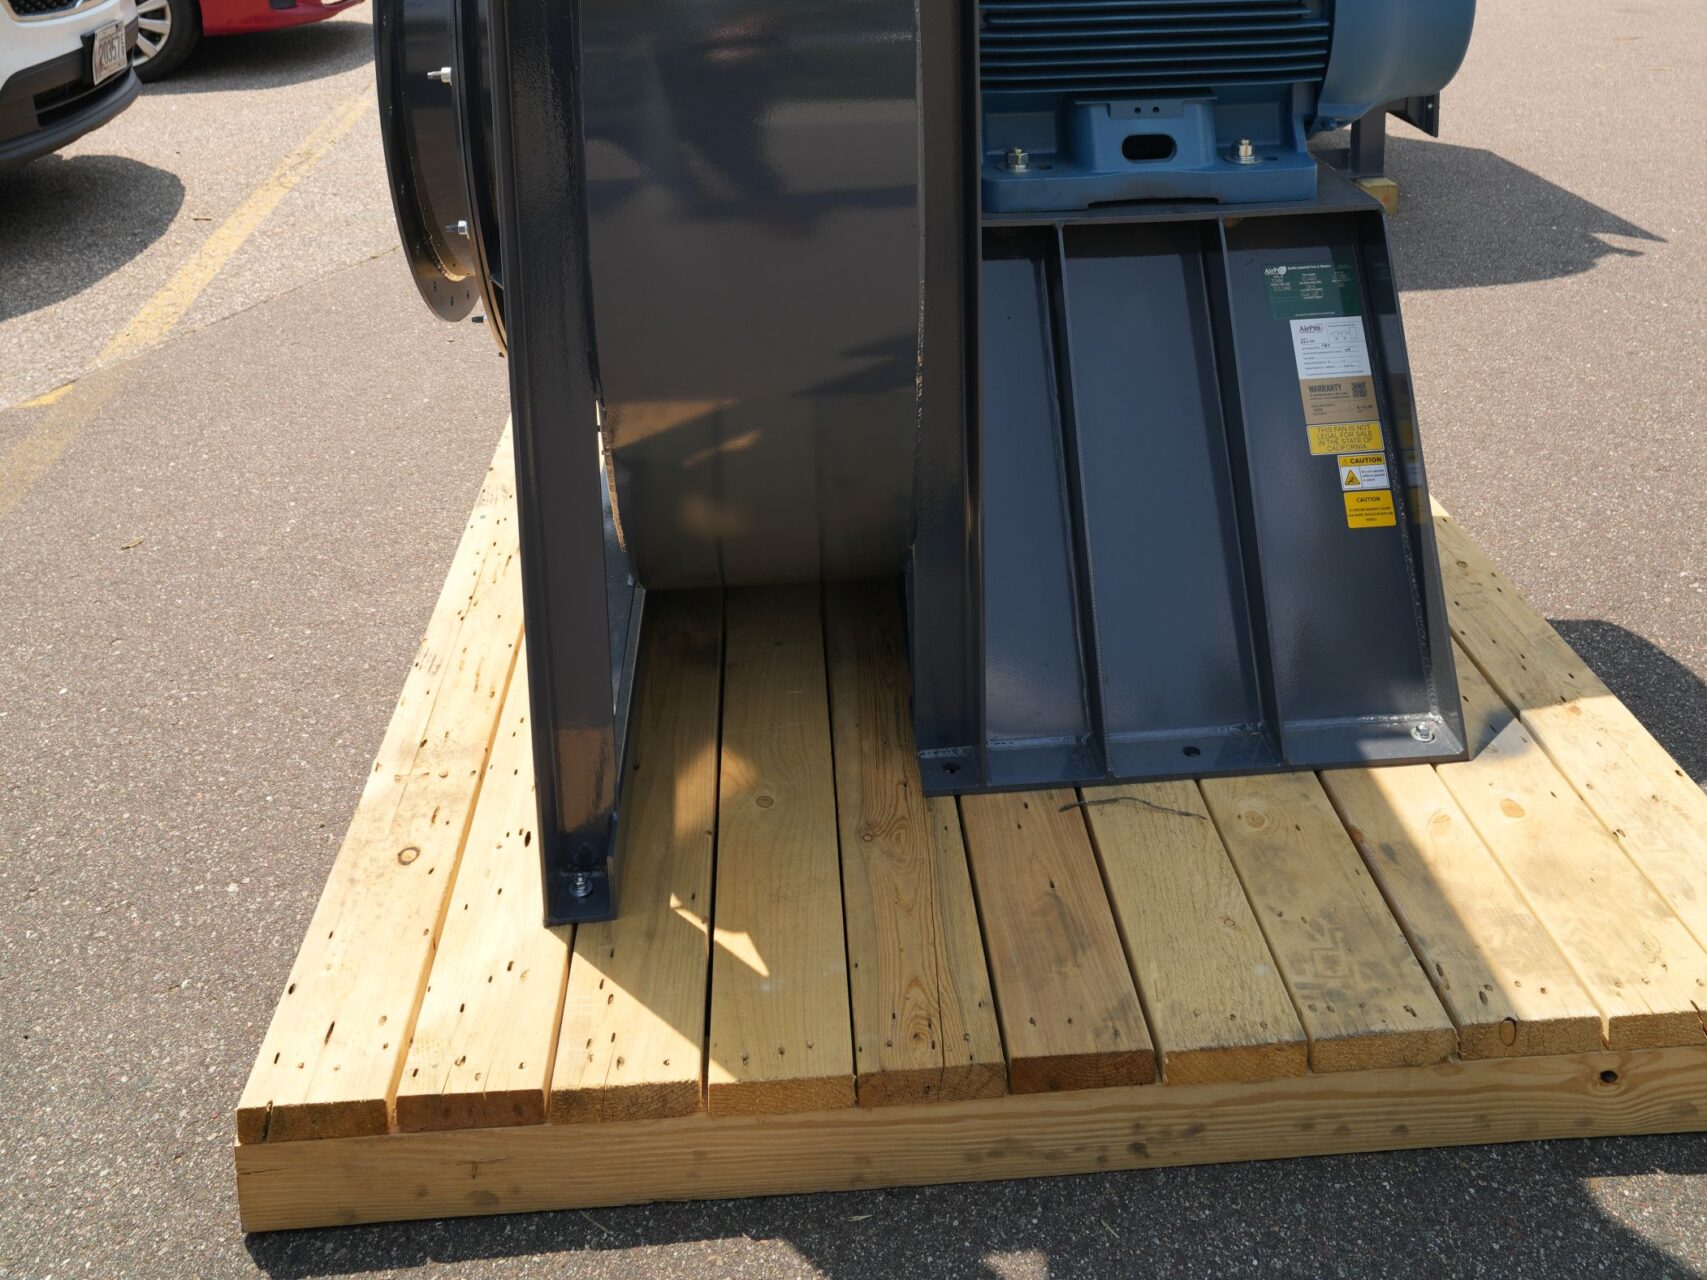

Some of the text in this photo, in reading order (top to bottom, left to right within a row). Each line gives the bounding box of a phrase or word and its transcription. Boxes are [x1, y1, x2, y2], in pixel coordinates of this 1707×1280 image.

[1299, 324, 1322, 333] AirPro
[1308, 384, 1342, 393] WARRANTY
[1350, 456, 1382, 464] CAUTION
